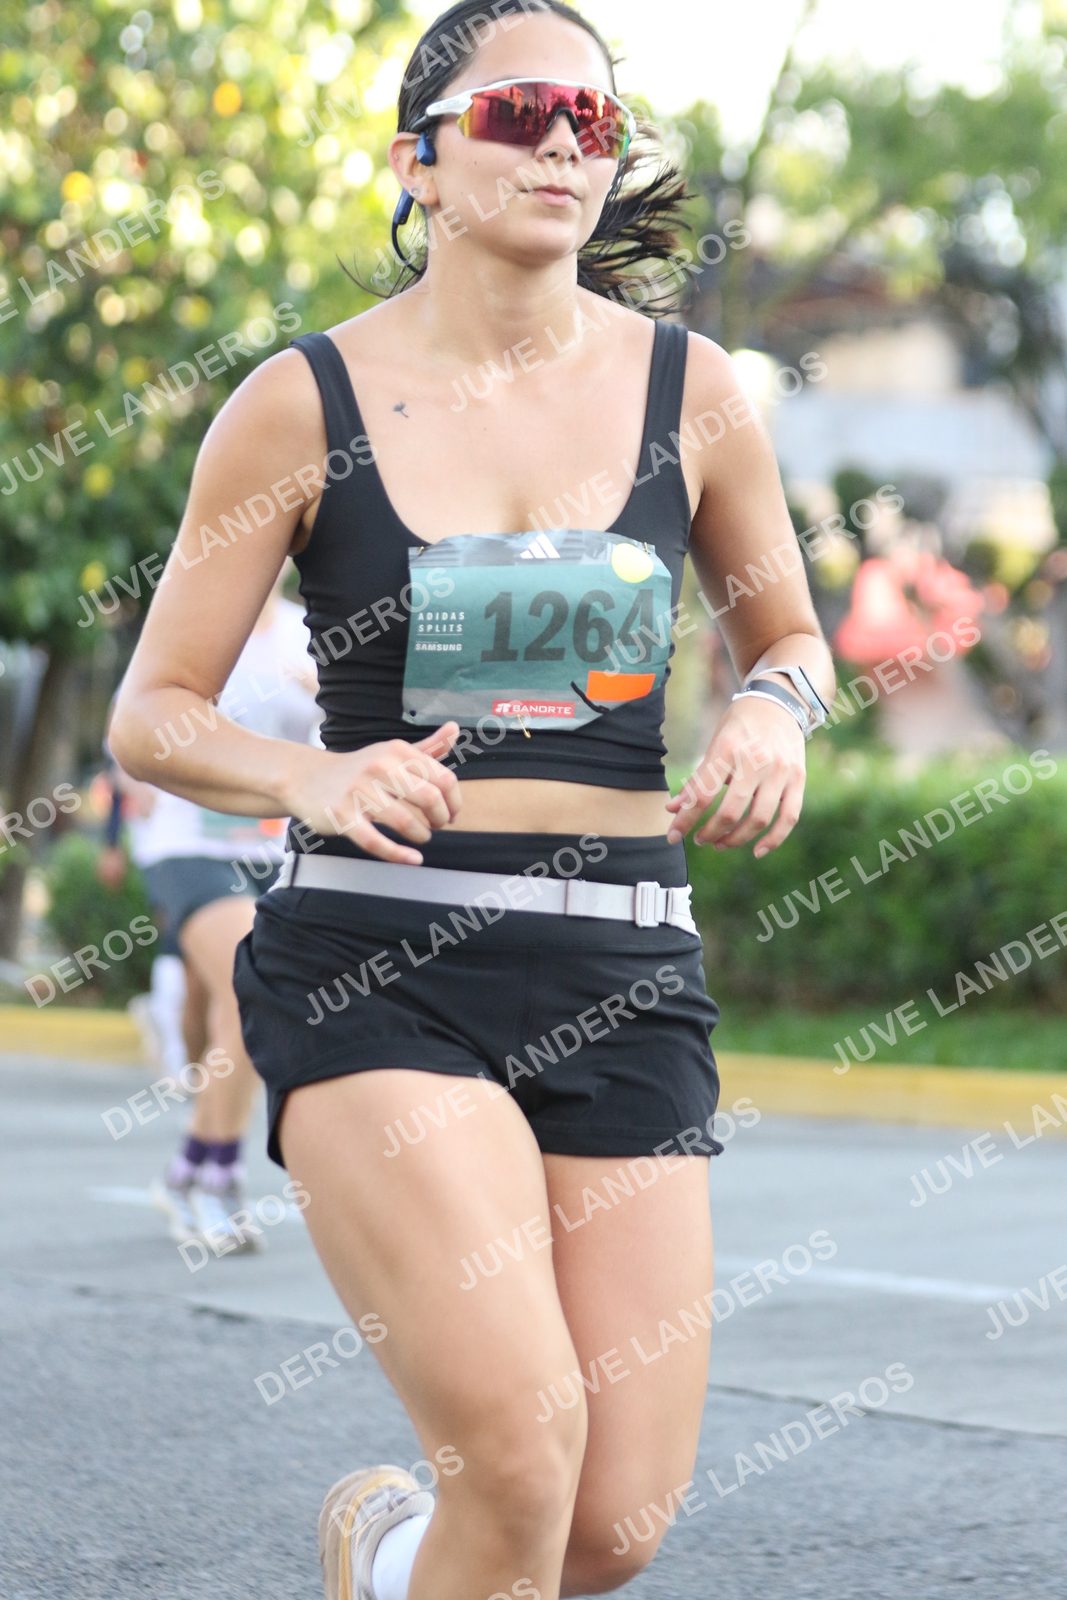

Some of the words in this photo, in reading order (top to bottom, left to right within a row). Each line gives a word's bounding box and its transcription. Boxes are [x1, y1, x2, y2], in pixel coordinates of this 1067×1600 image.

[418, 612, 465, 621] ADIDAS
[418, 624, 463, 633] SPLITS
[481, 589, 660, 663] 1264
[415, 643, 462, 651] SAMSUNG
[512, 704, 572, 714] BANORTE
